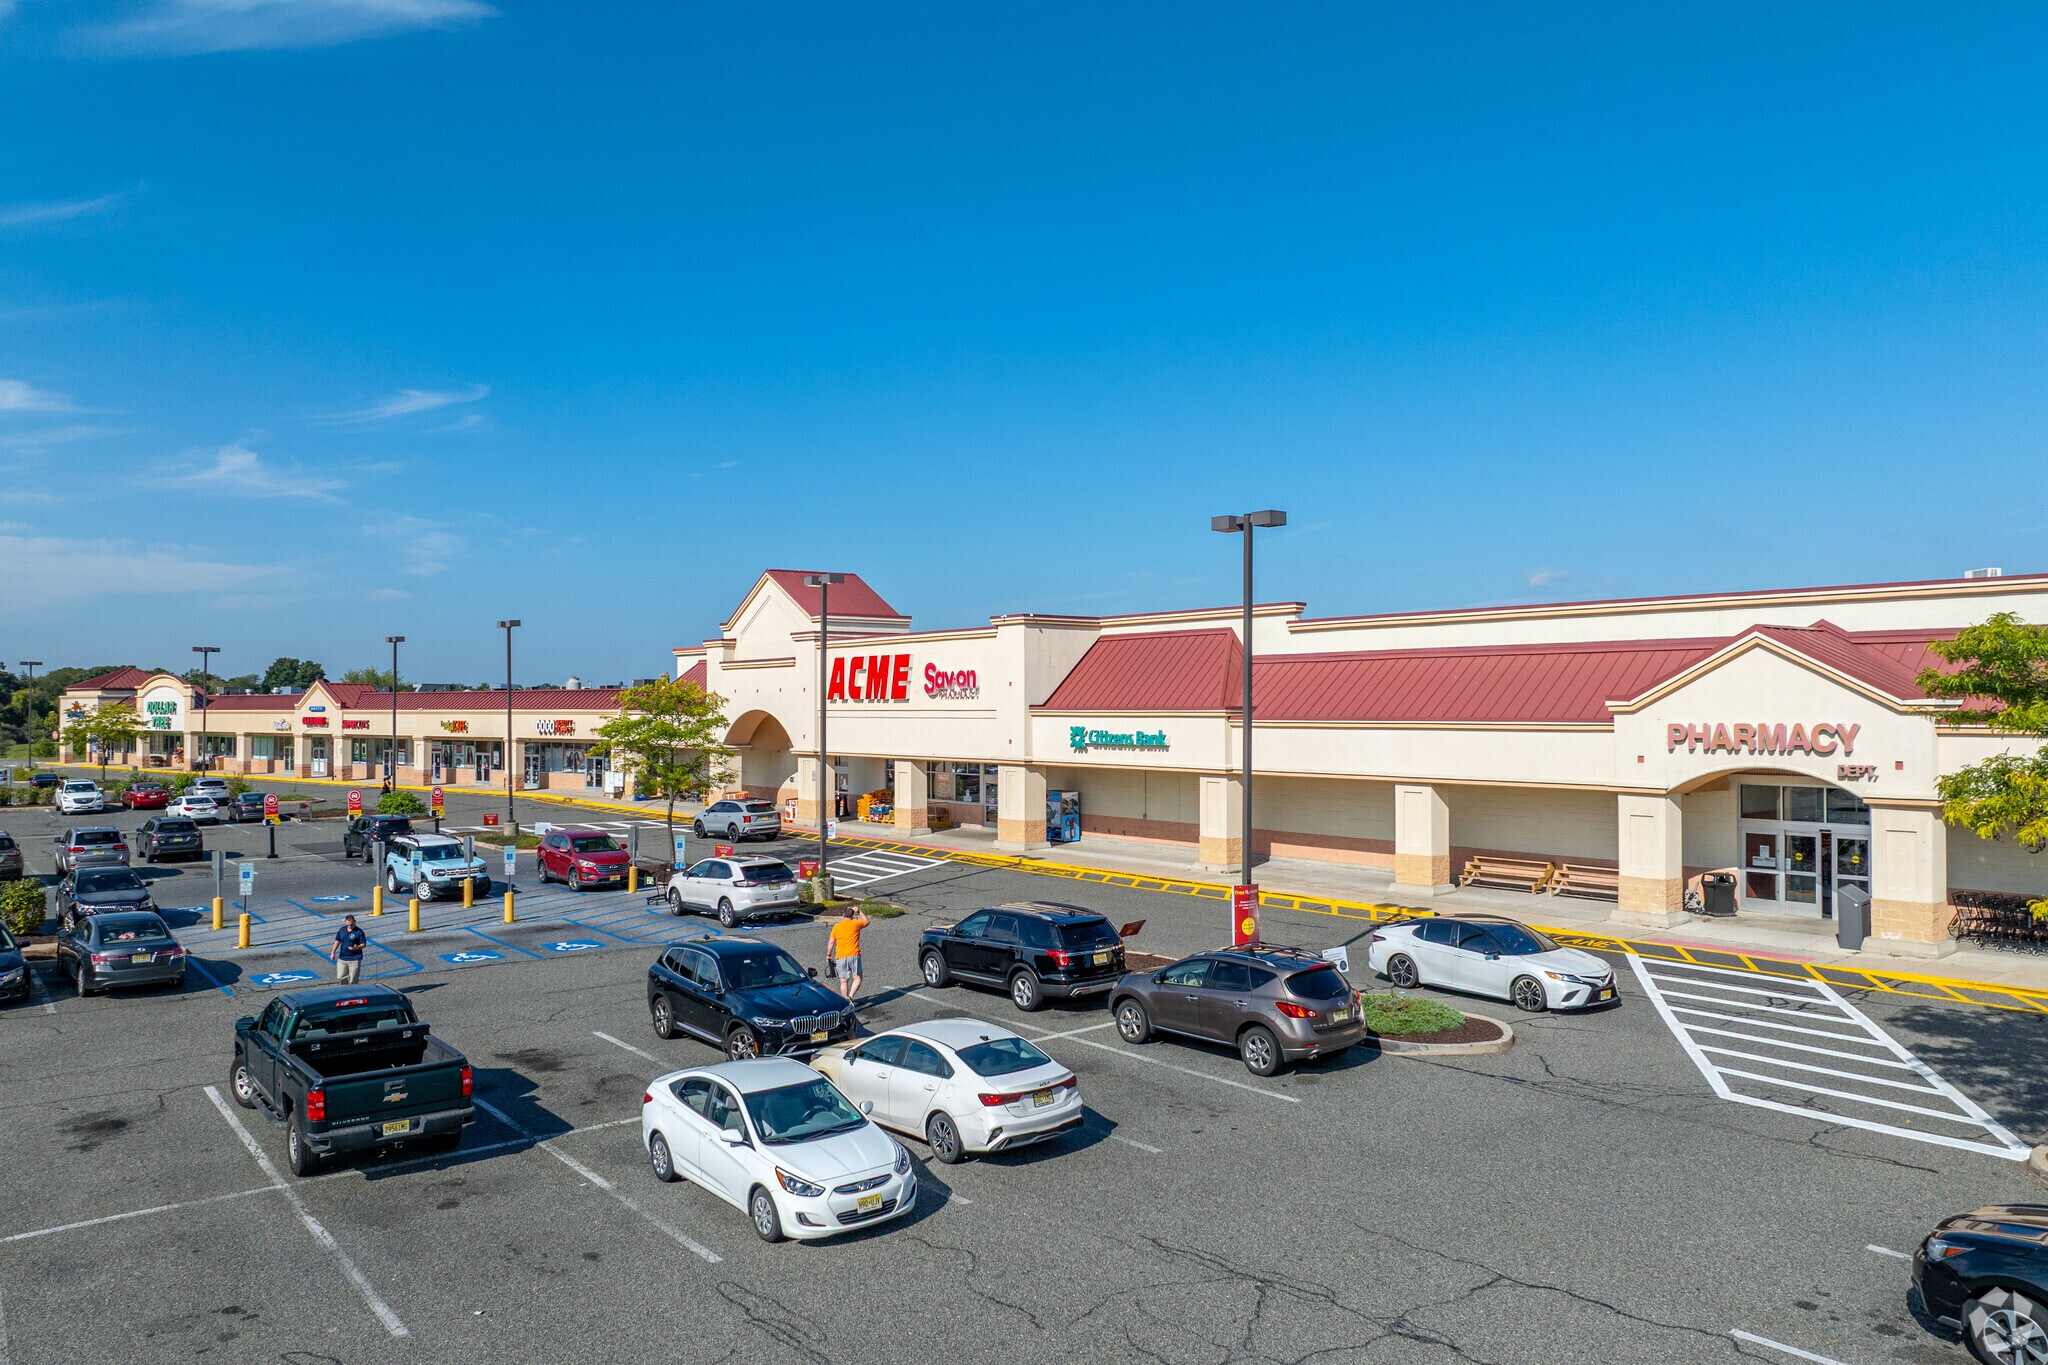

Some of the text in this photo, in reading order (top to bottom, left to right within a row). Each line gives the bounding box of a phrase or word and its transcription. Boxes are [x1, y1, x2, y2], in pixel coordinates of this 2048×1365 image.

[827, 654, 911, 700] ACME
[146, 701, 176, 715] DOLLAR
[151, 716, 171, 730] TREE
[536, 720, 555, 733] COCO
[1088, 729, 1167, 746] Citizens Bank
[1667, 722, 1860, 753] PHARMACY
[1553, 936, 1611, 948] LANE
